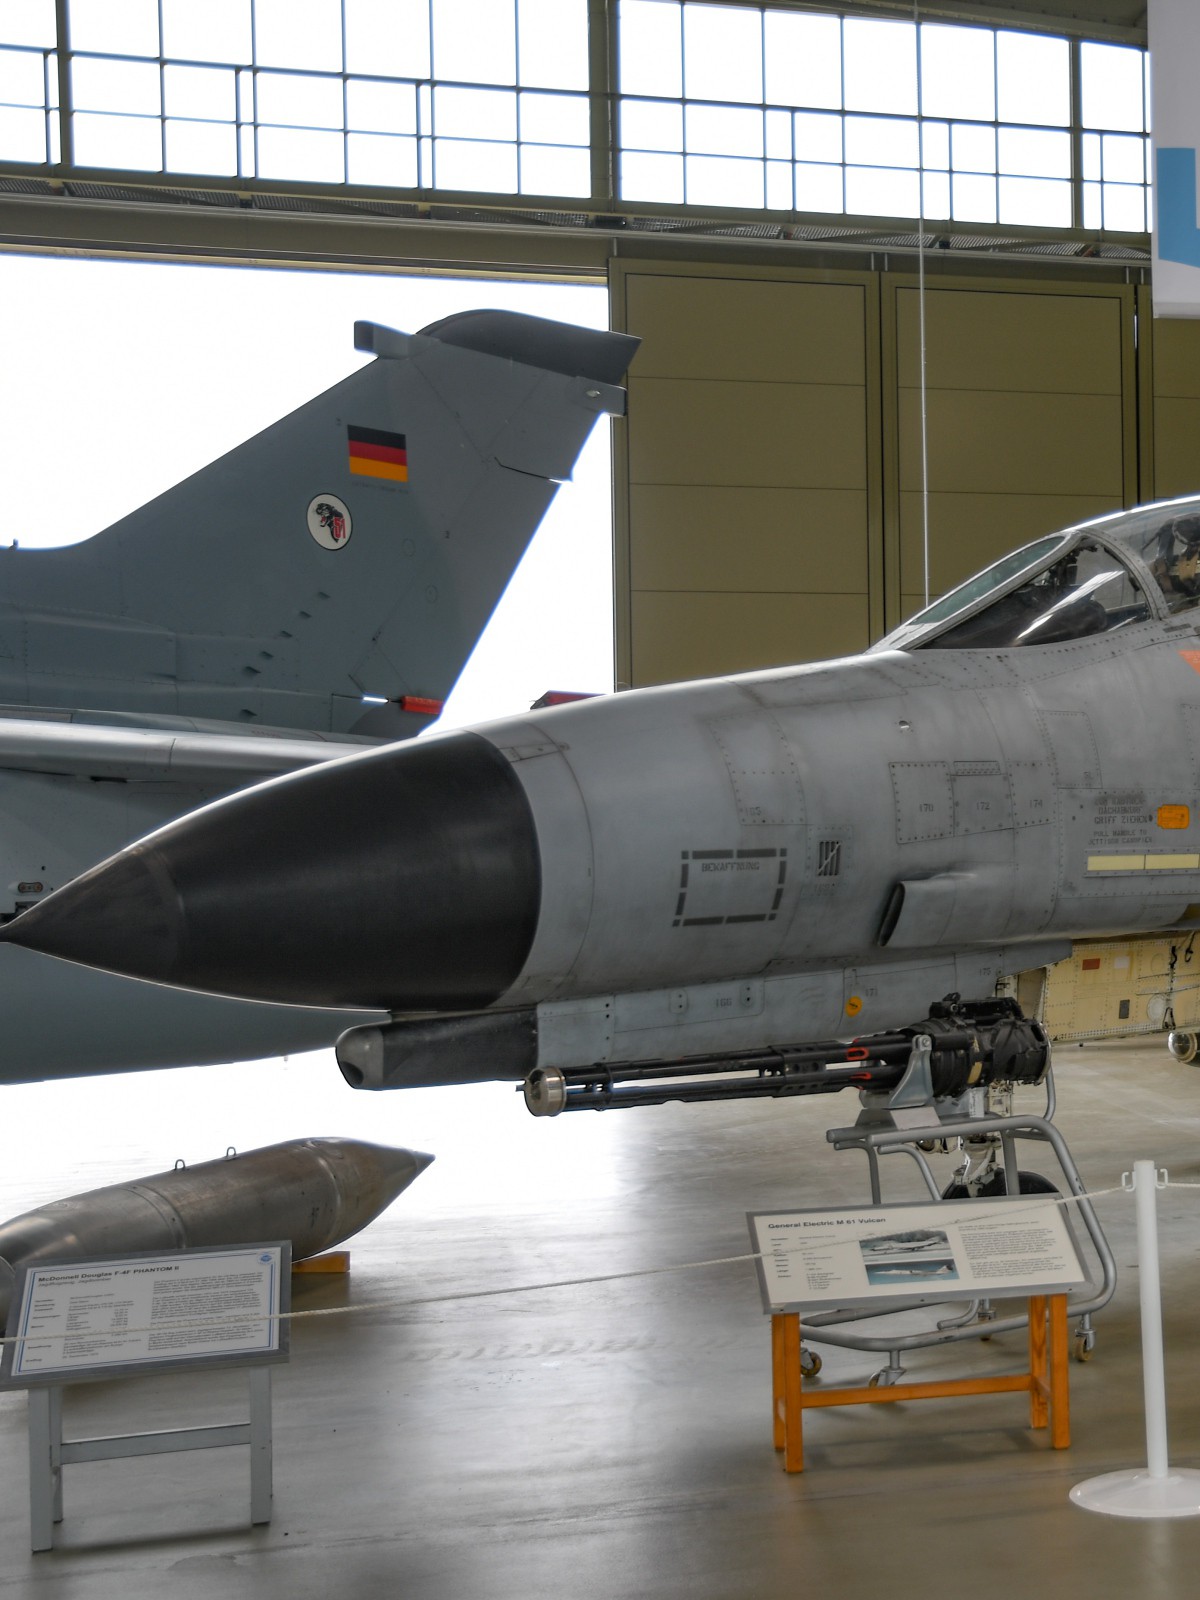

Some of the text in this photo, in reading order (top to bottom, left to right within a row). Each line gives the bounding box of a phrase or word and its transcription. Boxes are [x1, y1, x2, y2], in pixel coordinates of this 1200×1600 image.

[1094, 815, 1117, 824] GRIFF
[39, 1273, 80, 1282] McDonnell
[81, 1271, 113, 1280] Douglas
[133, 1266, 174, 1274] PHANTOM
